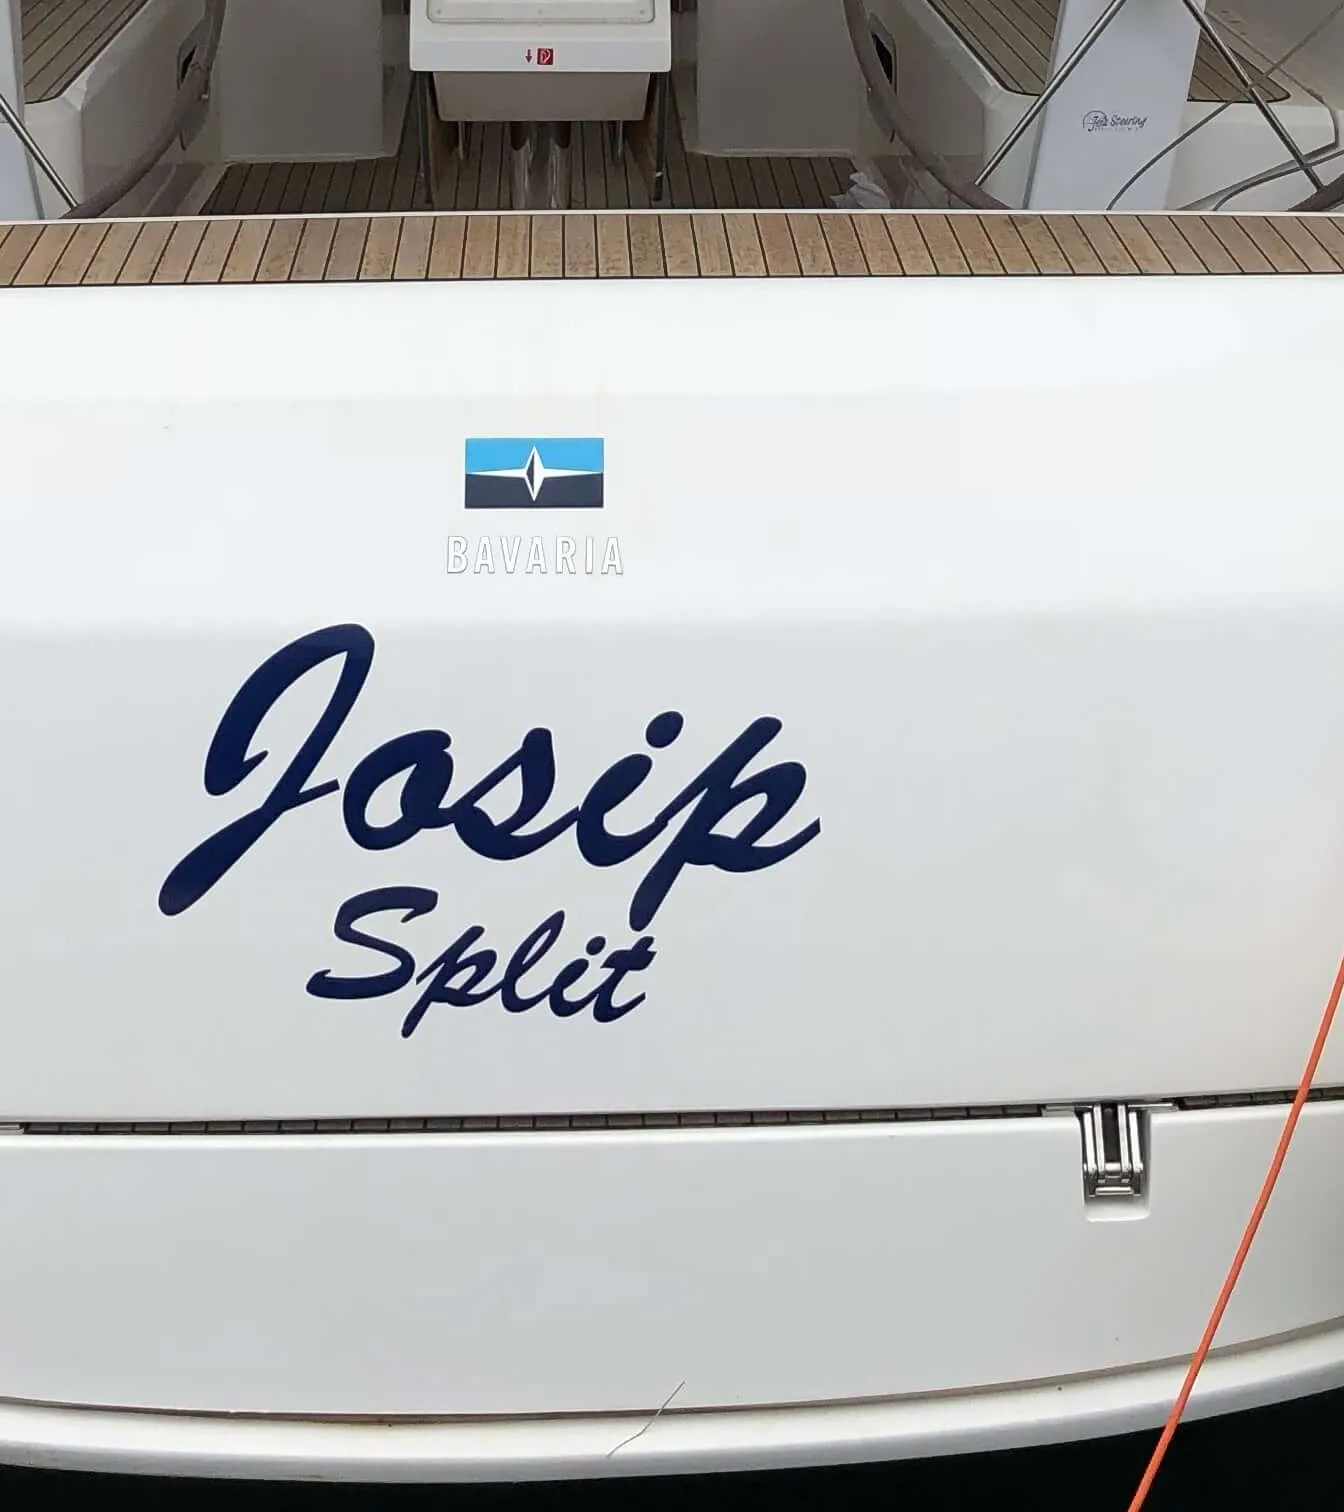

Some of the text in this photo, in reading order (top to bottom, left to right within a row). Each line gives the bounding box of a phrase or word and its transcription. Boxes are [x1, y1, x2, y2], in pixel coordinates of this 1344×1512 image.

[446, 535, 624, 575] BAVARIA
[158, 622, 821, 933] Josip
[305, 885, 657, 1039] Split
